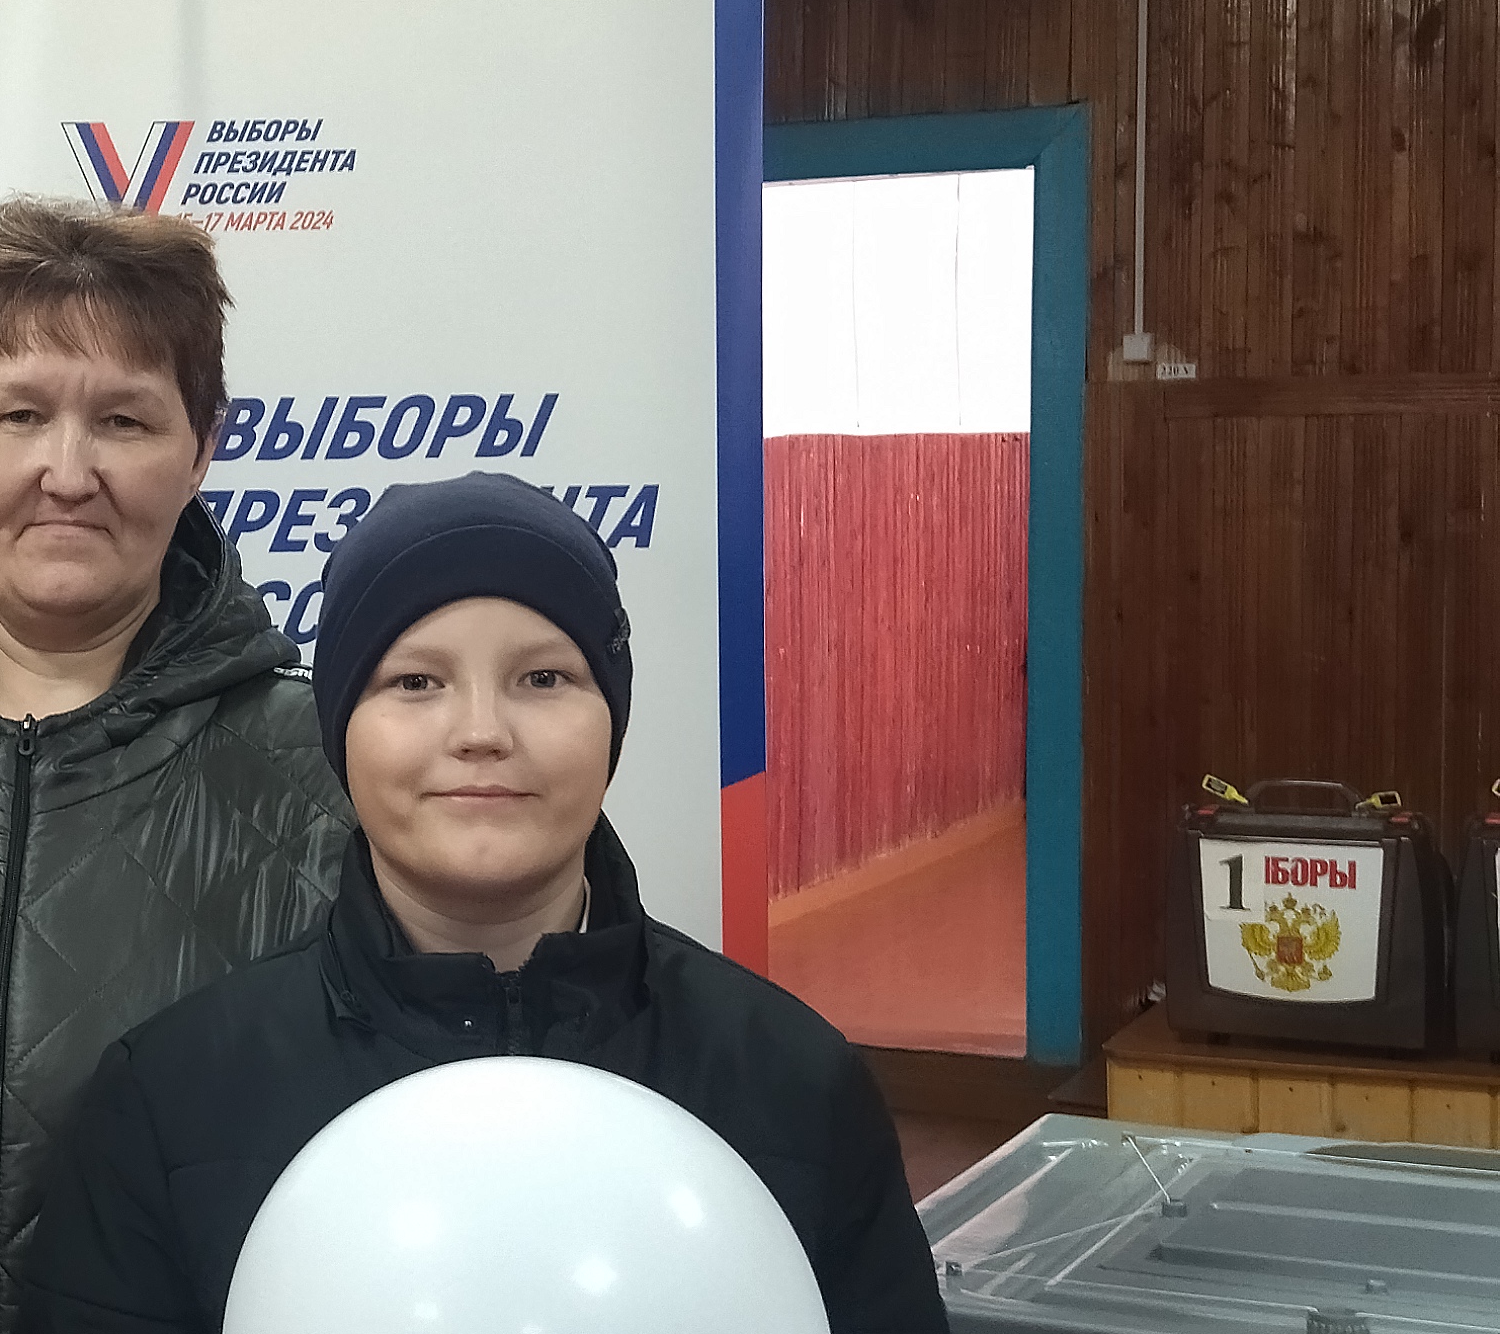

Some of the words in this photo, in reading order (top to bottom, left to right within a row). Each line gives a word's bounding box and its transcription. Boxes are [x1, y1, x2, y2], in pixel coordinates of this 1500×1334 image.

[206, 119, 323, 143] ВЫБОРЫ
[194, 149, 357, 176] ПРЕЗИДЕНТА
[181, 181, 287, 206] РОССИИ
[224, 212, 285, 232] МАРТА
[289, 210, 334, 231] 2024
[211, 393, 559, 461] ВЫБОРЫ
[1219, 853, 1251, 911] 1
[1264, 855, 1357, 890] БОРЫ
